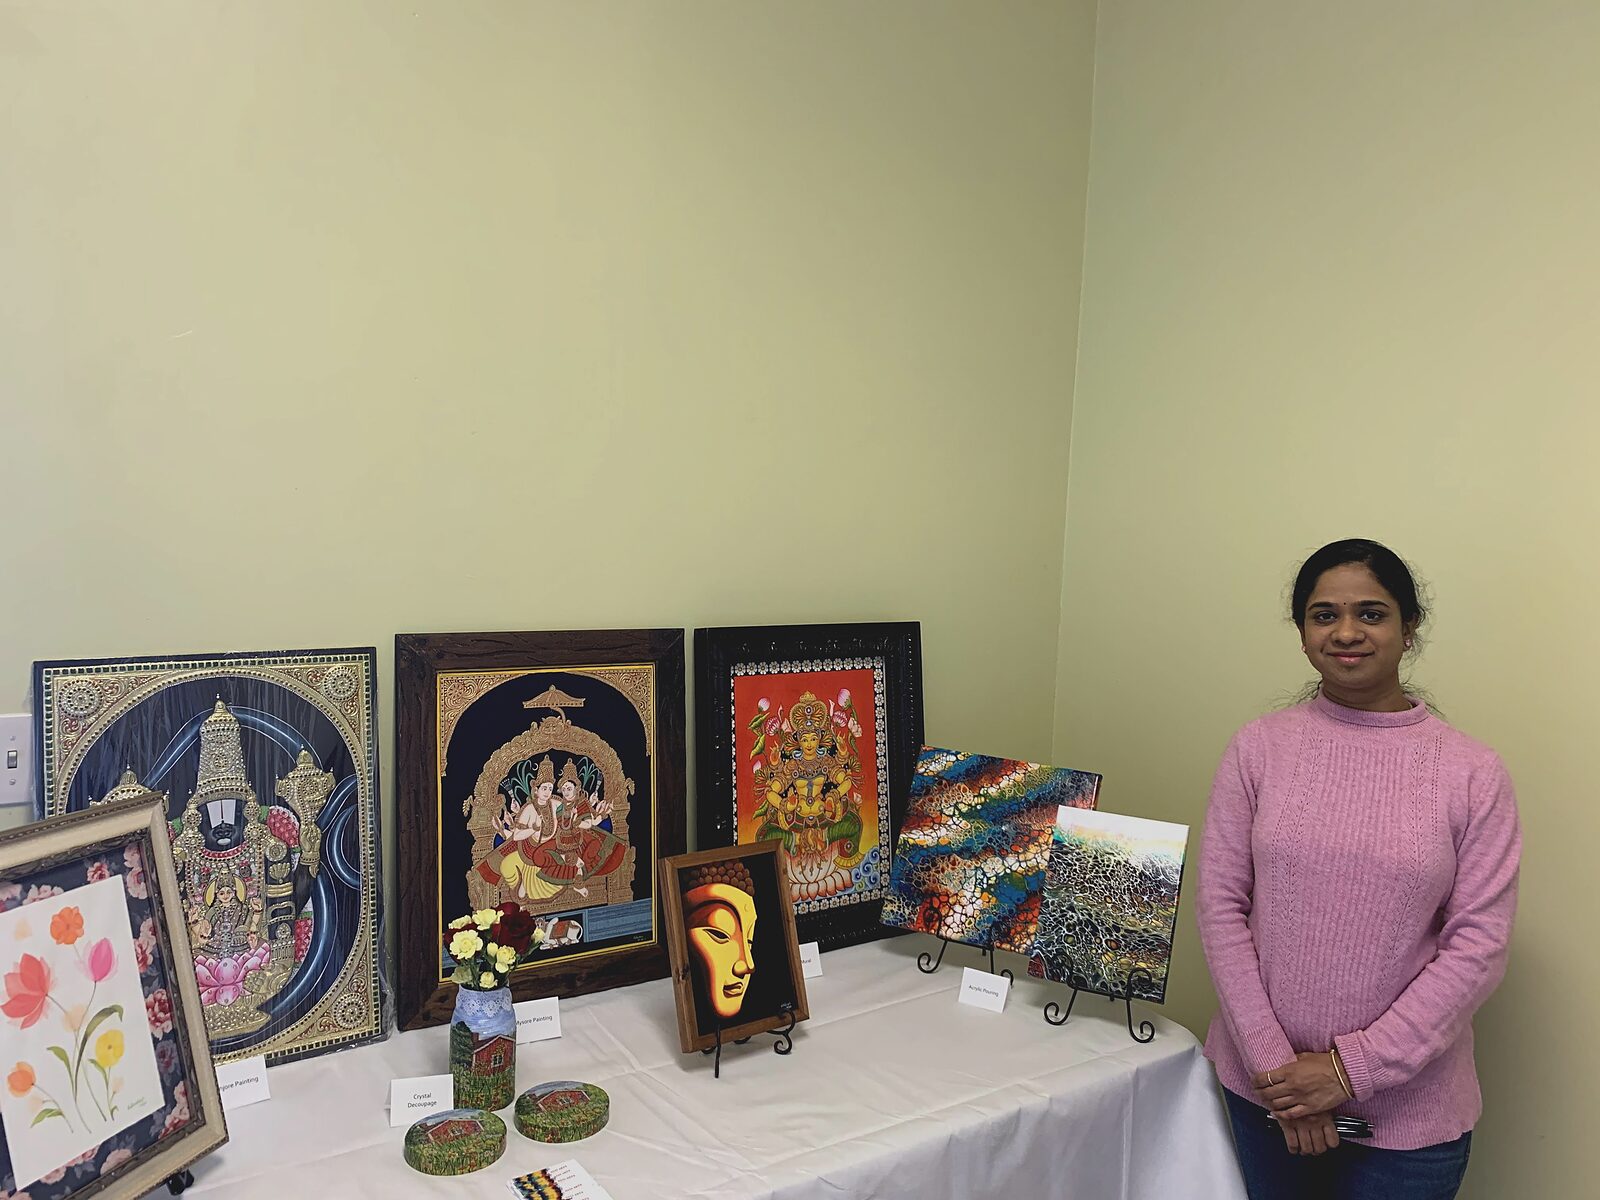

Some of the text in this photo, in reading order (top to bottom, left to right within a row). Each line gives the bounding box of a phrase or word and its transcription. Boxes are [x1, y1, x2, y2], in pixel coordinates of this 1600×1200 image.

[969, 984, 999, 997] Acrylic Pouring
[532, 1015, 553, 1023] Painting
[234, 1076, 259, 1087] Painting
[413, 1092, 432, 1100] Crystal
